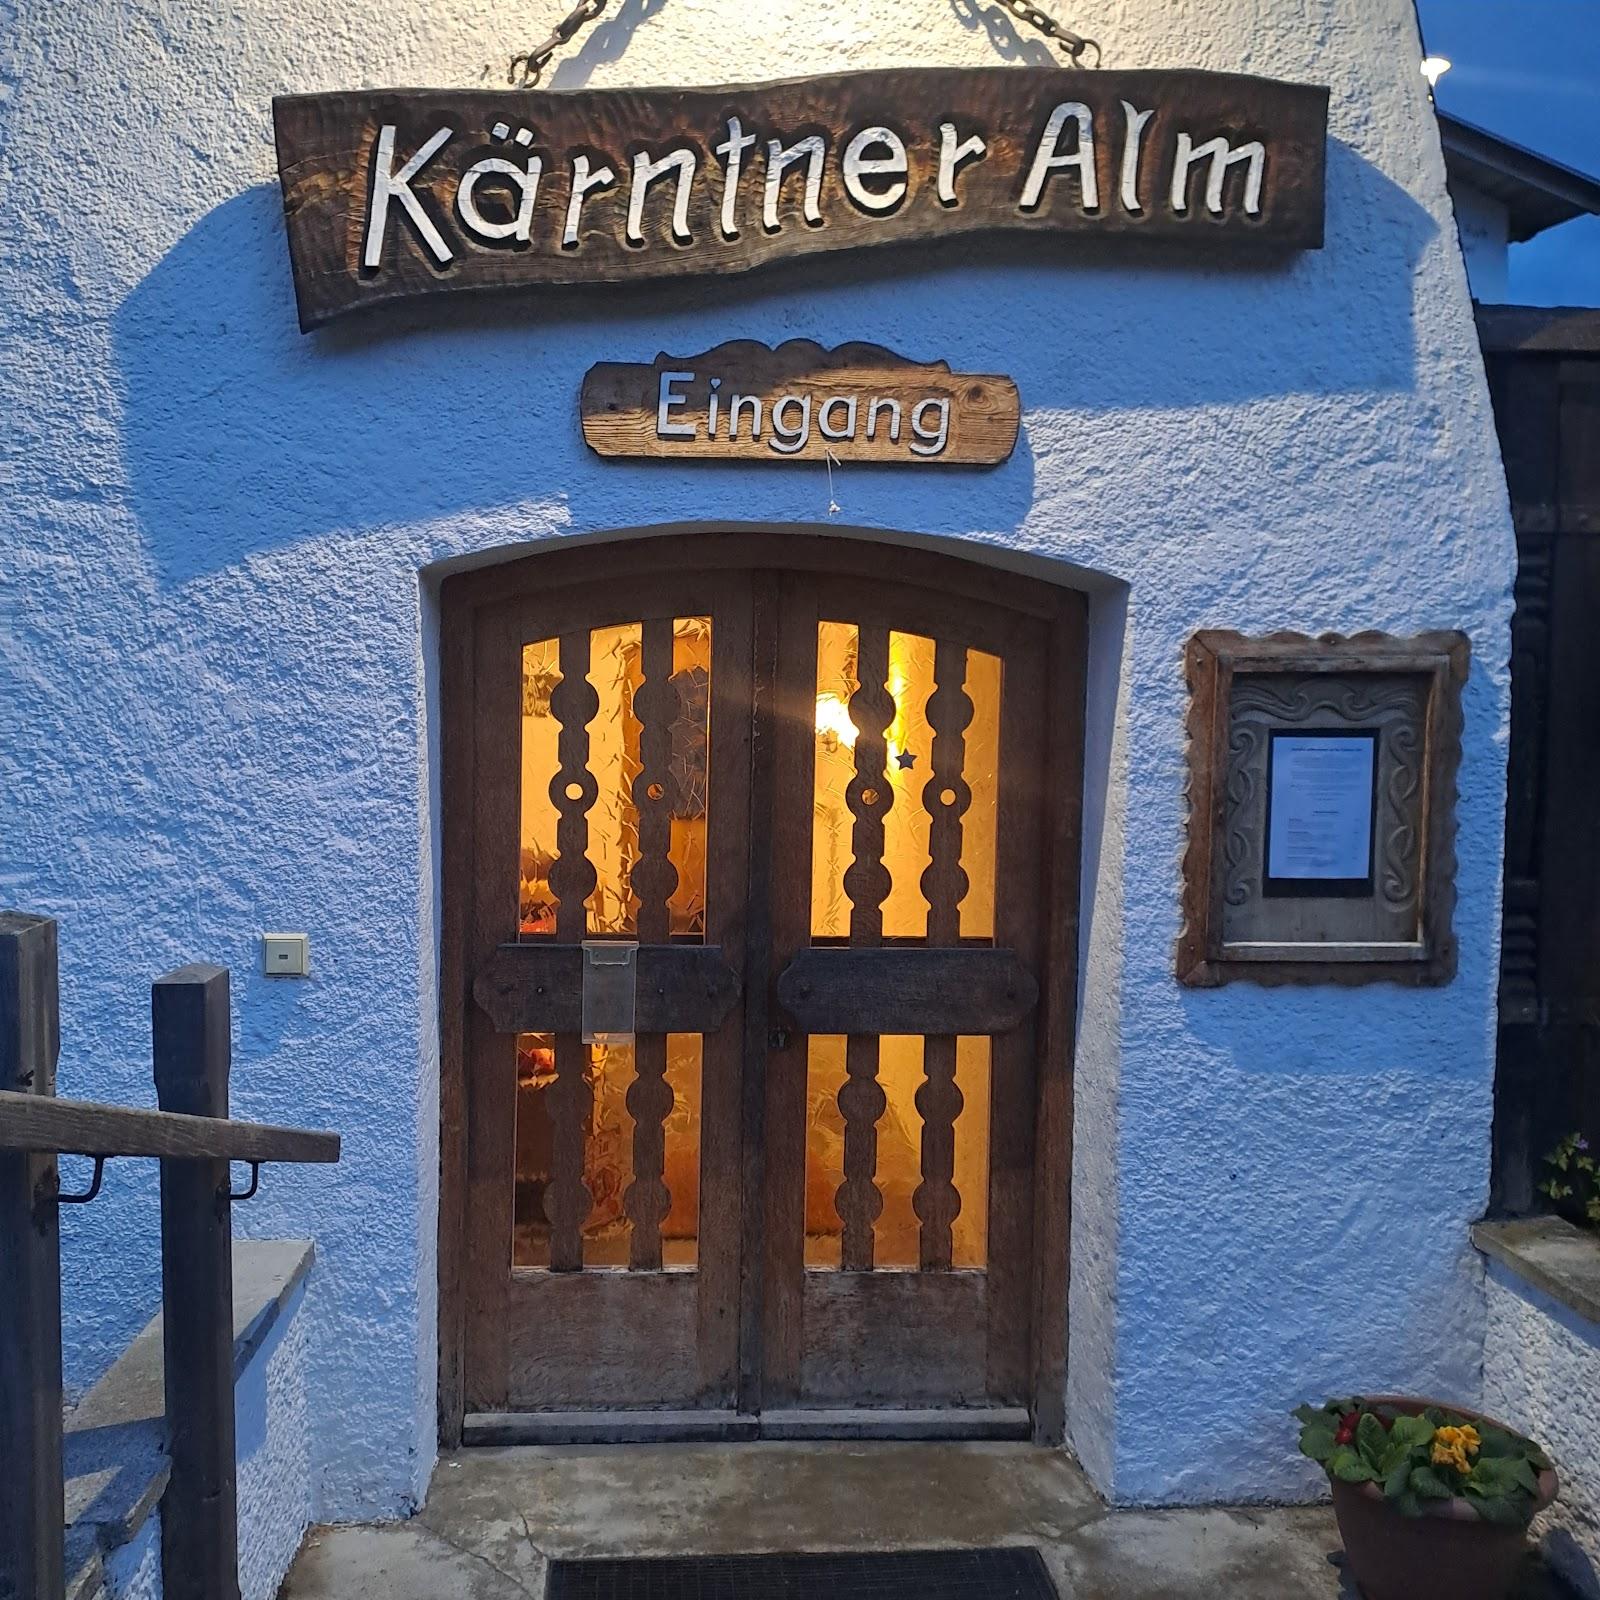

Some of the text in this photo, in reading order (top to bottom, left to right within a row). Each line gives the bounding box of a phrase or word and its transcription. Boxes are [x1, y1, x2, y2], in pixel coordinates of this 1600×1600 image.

[363, 99, 1267, 268] Kärntner Alm
[656, 370, 951, 454] Eingang
